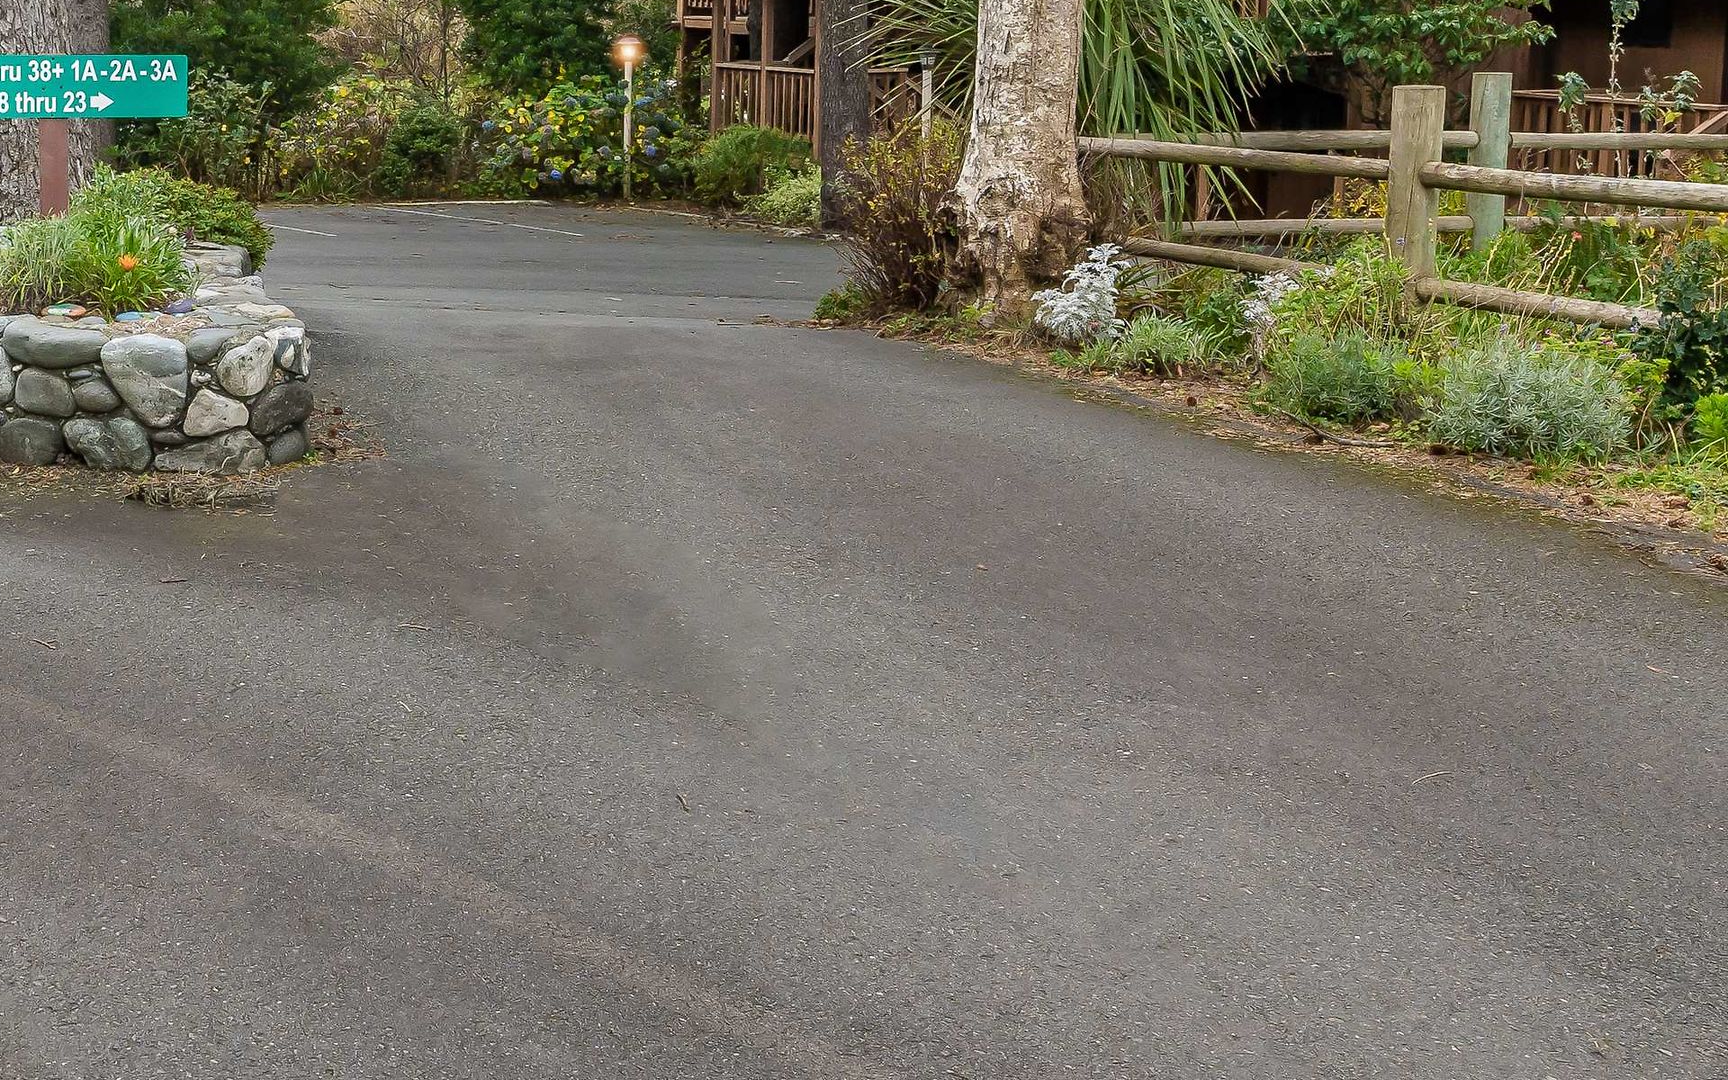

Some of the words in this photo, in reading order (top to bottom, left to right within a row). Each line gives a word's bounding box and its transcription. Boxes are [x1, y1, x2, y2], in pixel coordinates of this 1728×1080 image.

[27, 59, 64, 82] 38+
[14, 91, 57, 113] thru
[63, 90, 87, 113] 23
